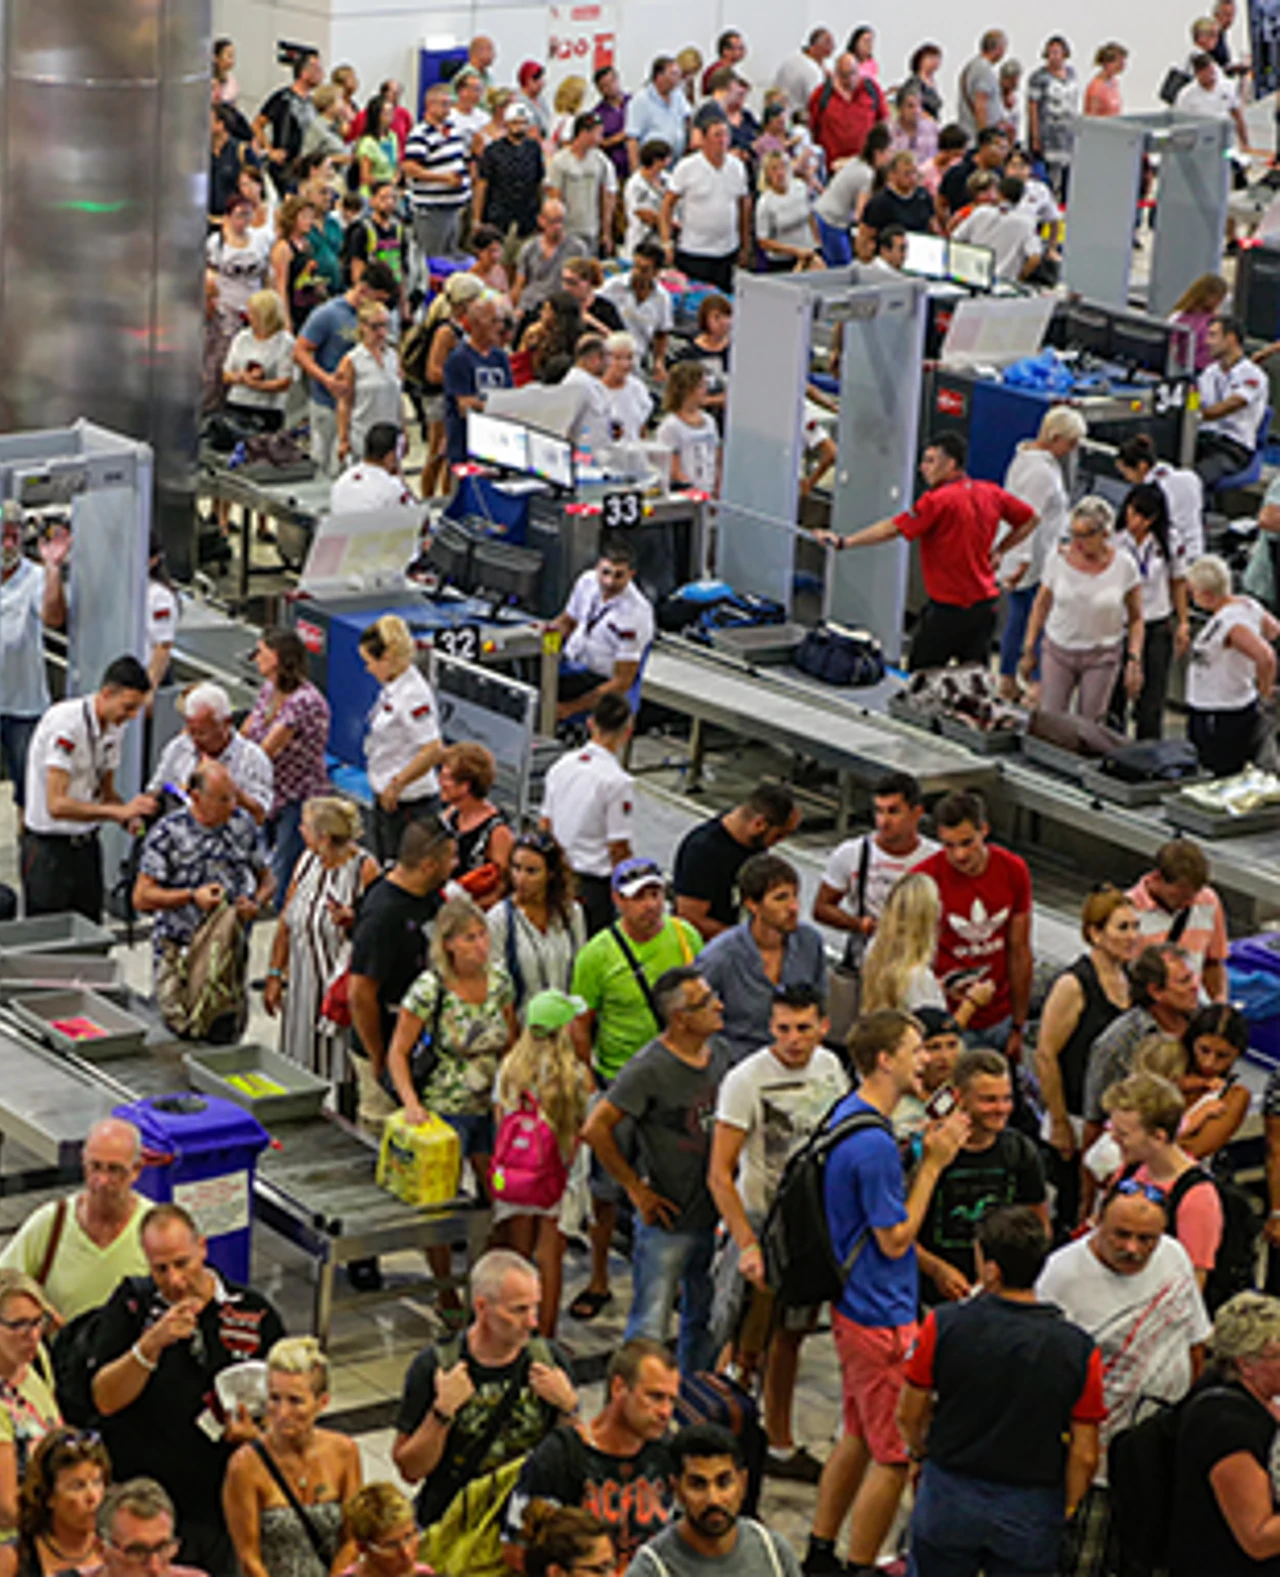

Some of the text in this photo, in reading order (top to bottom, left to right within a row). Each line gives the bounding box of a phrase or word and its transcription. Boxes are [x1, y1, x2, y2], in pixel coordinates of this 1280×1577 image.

[1156, 382, 1184, 413] 34
[606, 494, 638, 526] 33
[440, 628, 477, 659] 32
